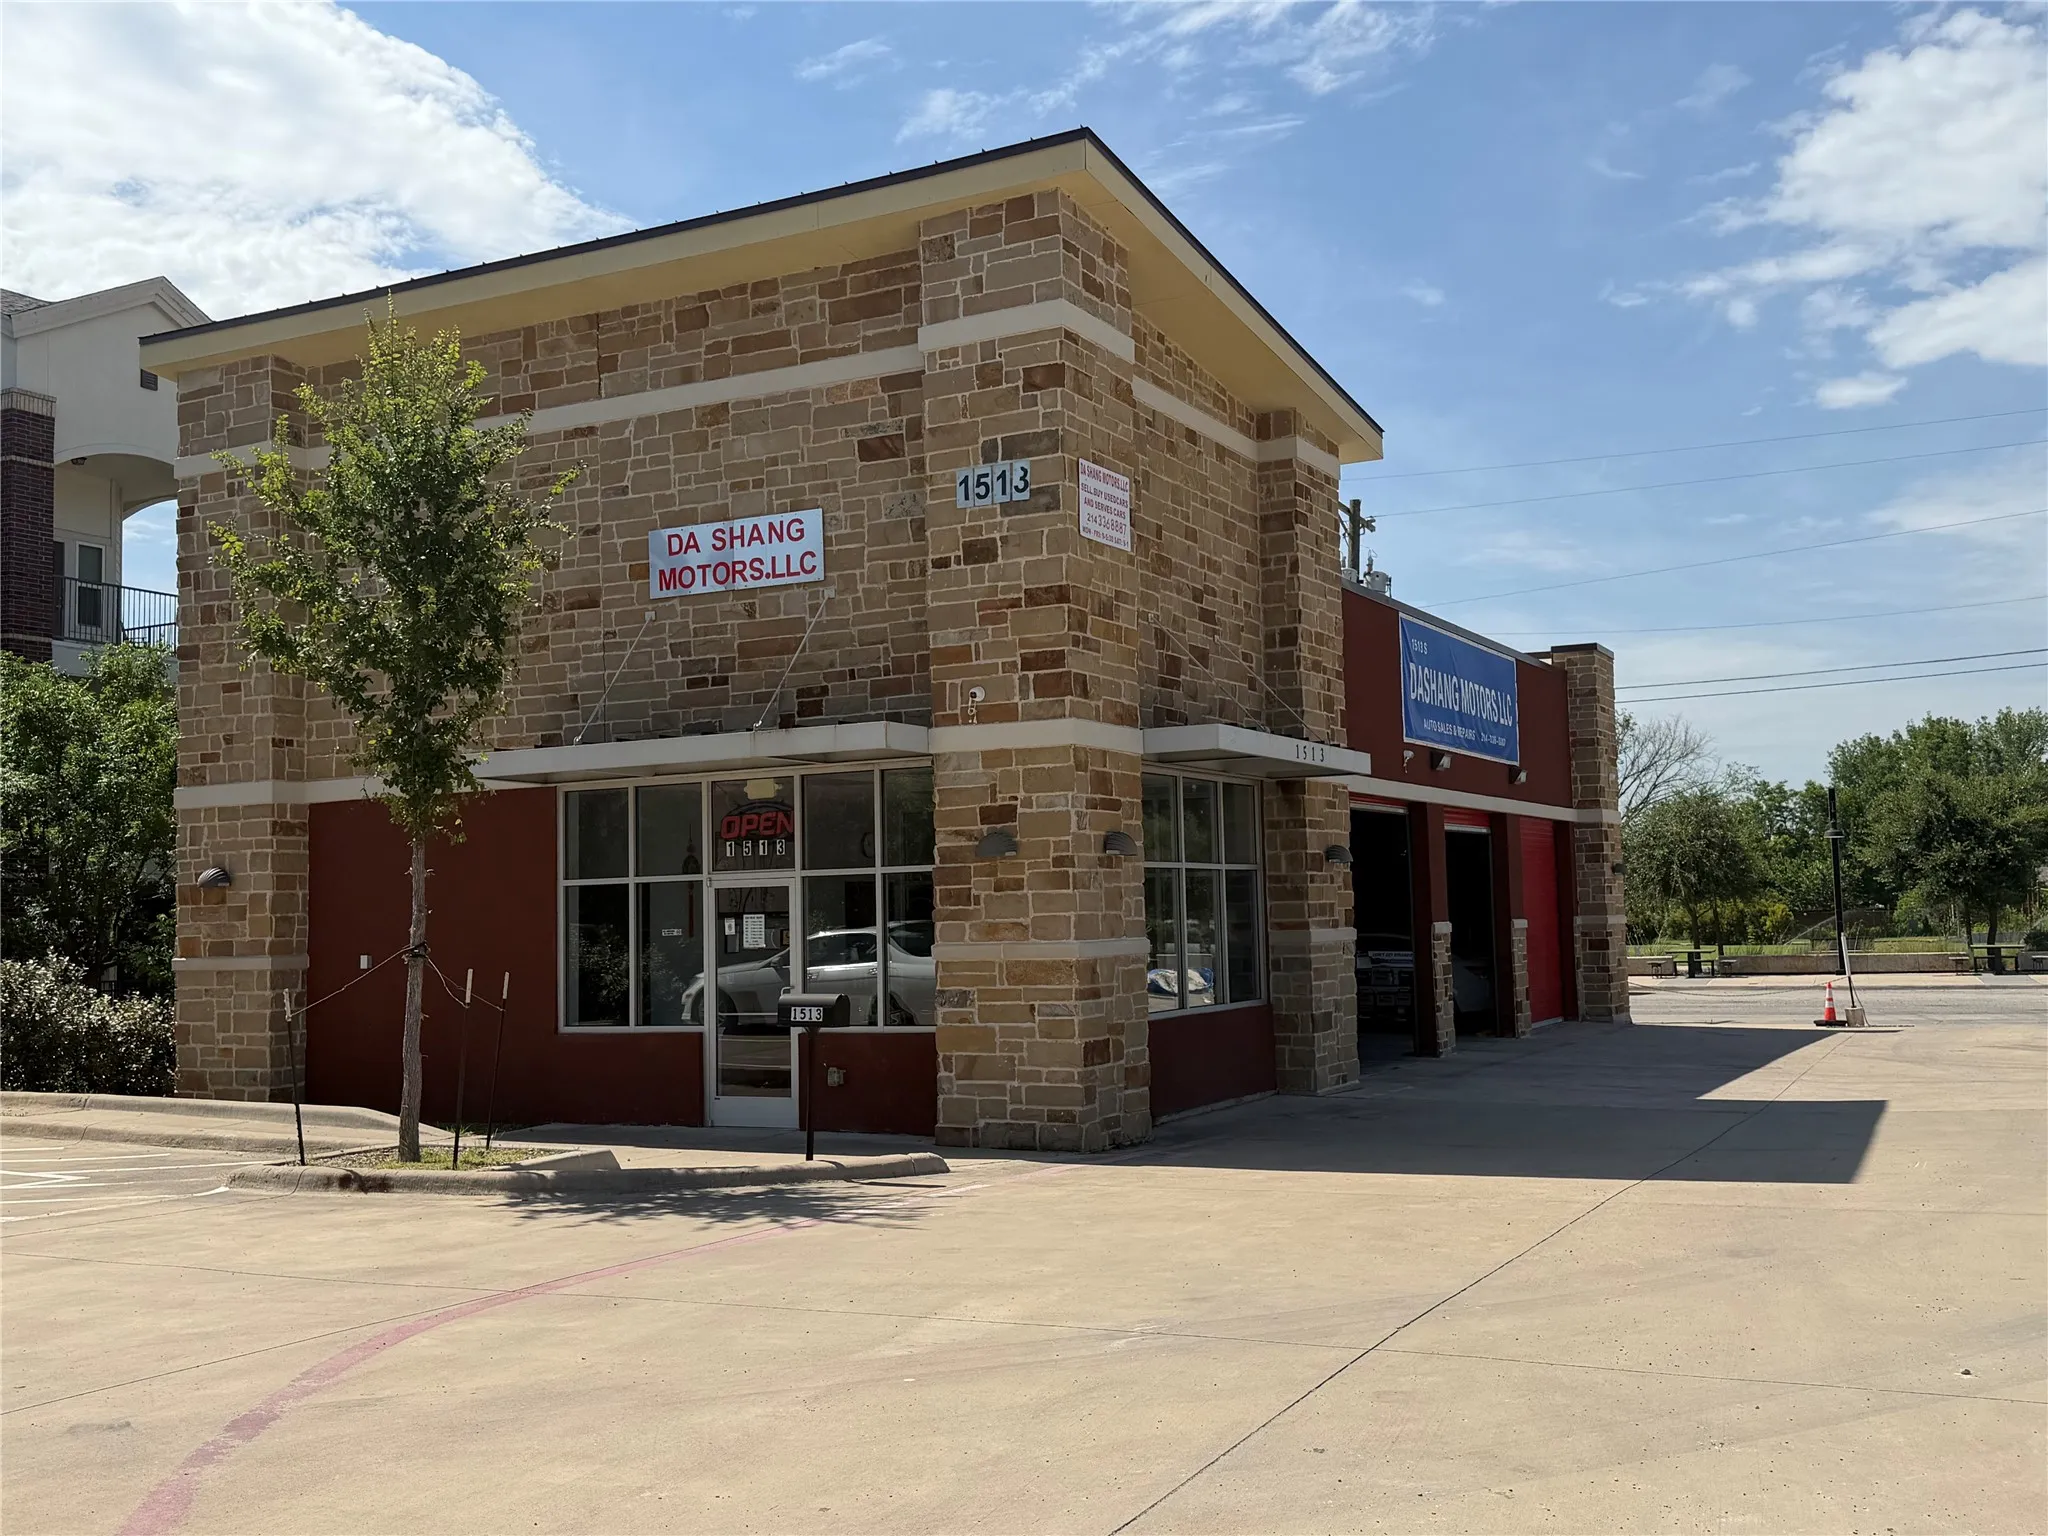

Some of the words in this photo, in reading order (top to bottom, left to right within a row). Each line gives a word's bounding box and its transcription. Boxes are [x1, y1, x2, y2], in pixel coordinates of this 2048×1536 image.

[958, 466, 1030, 501] 1513
[1083, 496, 1094, 508] AND
[1094, 501, 1113, 515] SERVES
[1113, 508, 1126, 520] CARS
[667, 531, 701, 557] DA
[711, 518, 805, 551] SHANG
[658, 550, 817, 591] MOTORS.LLC
[1411, 638, 1423, 654] 1513
[1409, 662, 1459, 711] DASHANG
[1460, 678, 1498, 723] MOTORS
[1498, 692, 1513, 727] LLC
[1423, 718, 1437, 732] AUTO
[1437, 721, 1452, 735] SALES
[1296, 744, 1324, 762] 1513
[721, 811, 794, 839] OPEN
[792, 1008, 822, 1021] 1513
